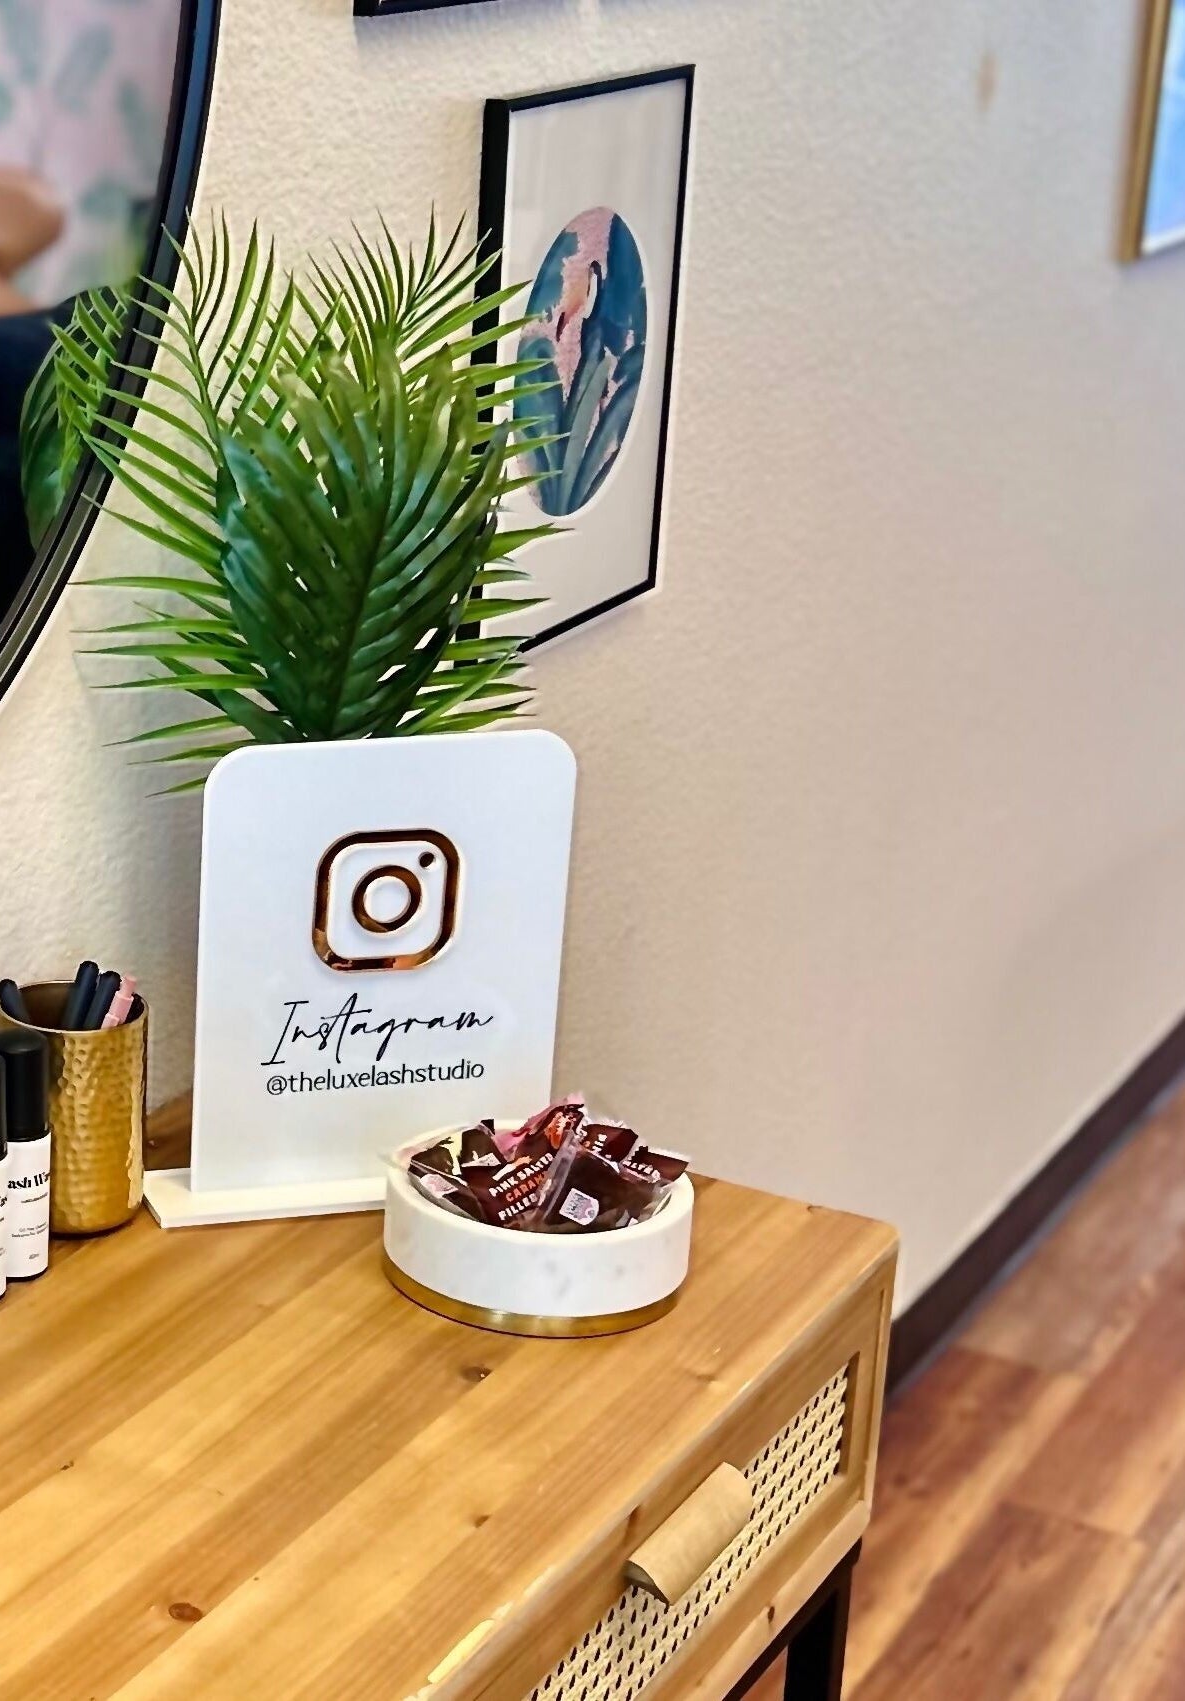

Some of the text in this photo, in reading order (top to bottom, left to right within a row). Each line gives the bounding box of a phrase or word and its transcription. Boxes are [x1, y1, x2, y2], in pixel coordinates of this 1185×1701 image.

[261, 992, 494, 1066] Instagram
[266, 1058, 485, 1096] @theluxelashstudio
[7, 1176, 32, 1189] ash
[488, 1176, 519, 1197] PINK
